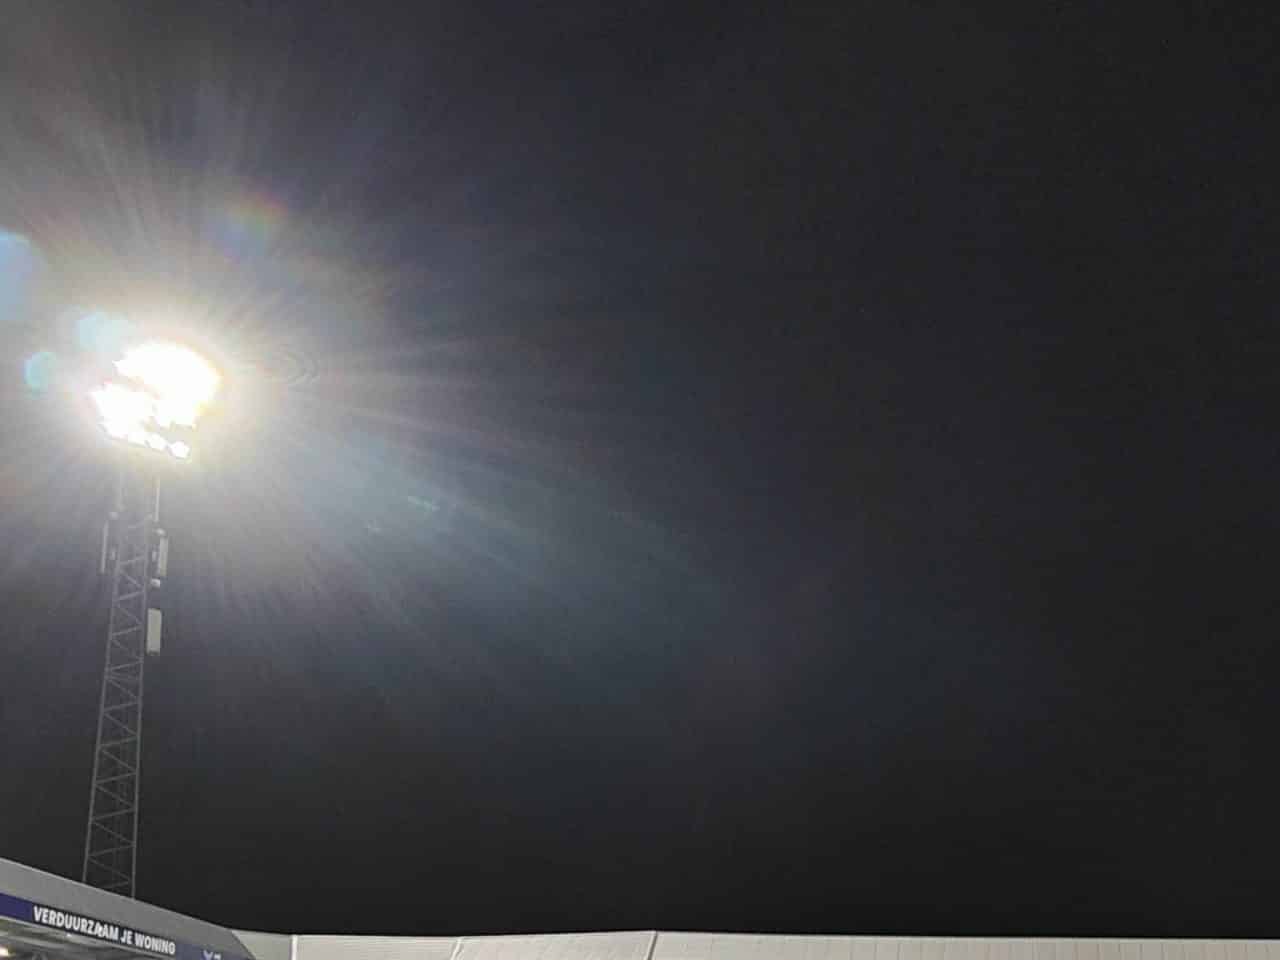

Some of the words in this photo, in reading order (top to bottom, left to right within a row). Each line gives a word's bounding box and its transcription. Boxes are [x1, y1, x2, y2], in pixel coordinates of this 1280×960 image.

[33, 905, 119, 941] VERDUURZAAM
[120, 929, 133, 945] JE
[134, 932, 176, 955] WONING
